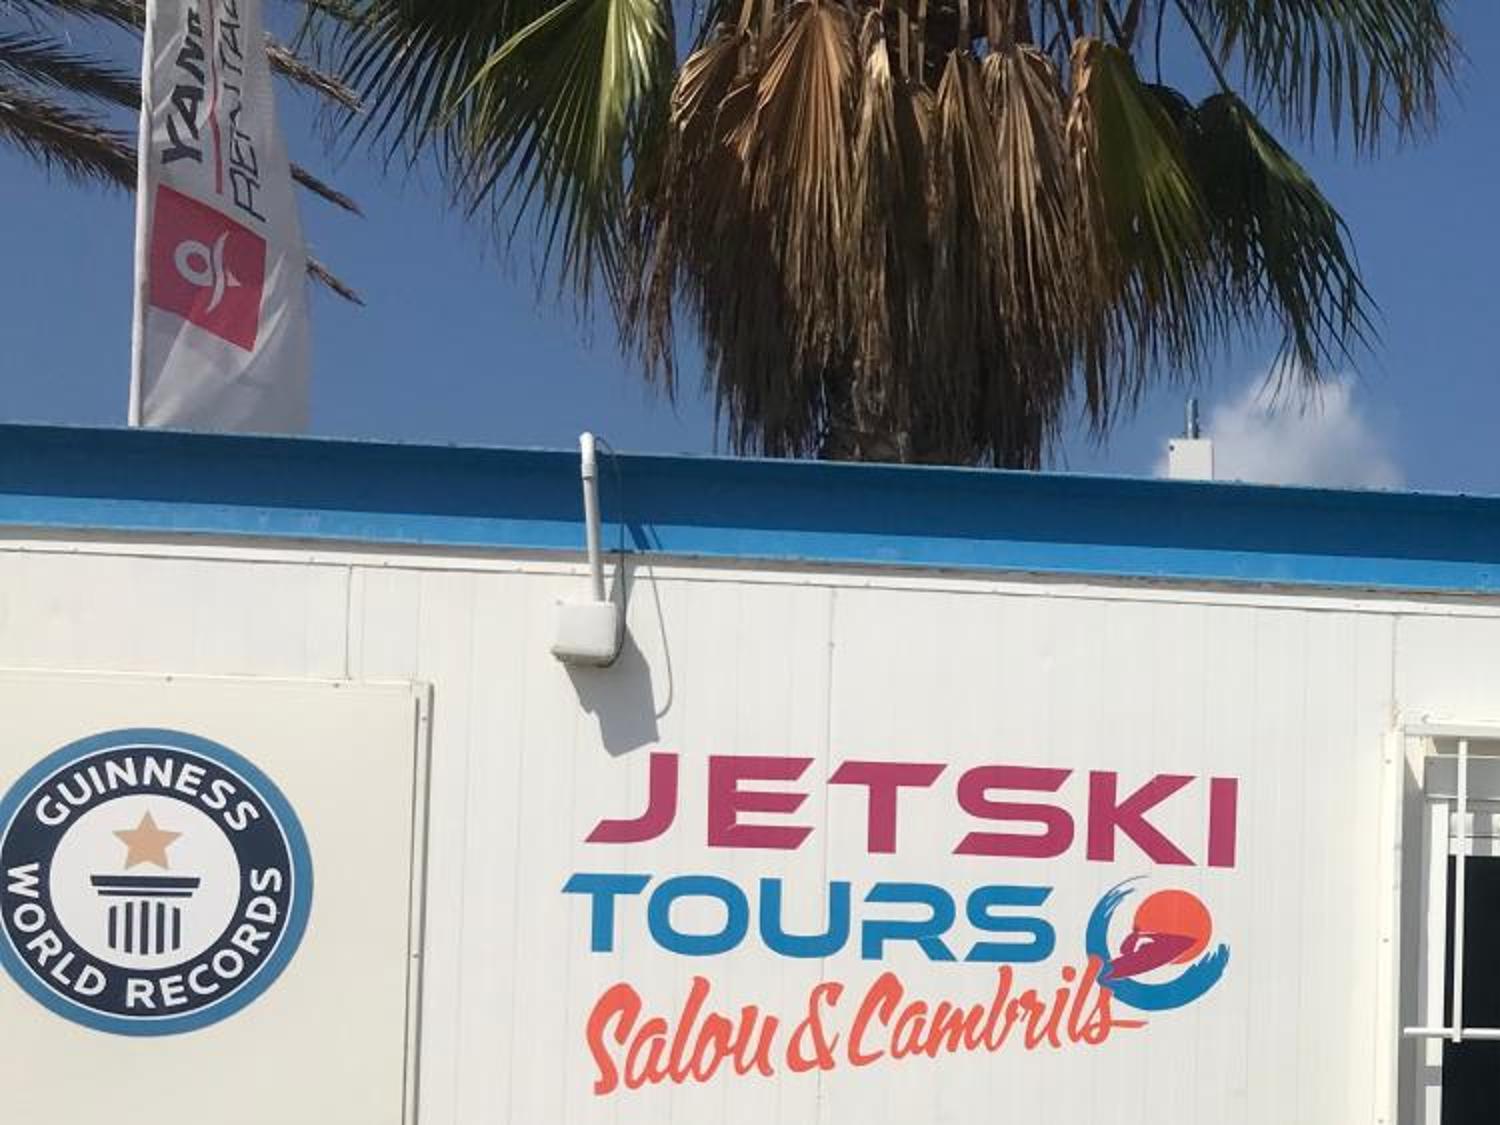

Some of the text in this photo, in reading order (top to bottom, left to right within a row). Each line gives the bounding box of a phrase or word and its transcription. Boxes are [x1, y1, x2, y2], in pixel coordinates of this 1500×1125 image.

[36, 756, 259, 831] GUINNESS
[584, 752, 1239, 868] JETSKI
[7, 862, 283, 1009] WORLD RECORDS
[562, 873, 1056, 963] TOURS
[586, 955, 1149, 1095] Salou & Cambrils
